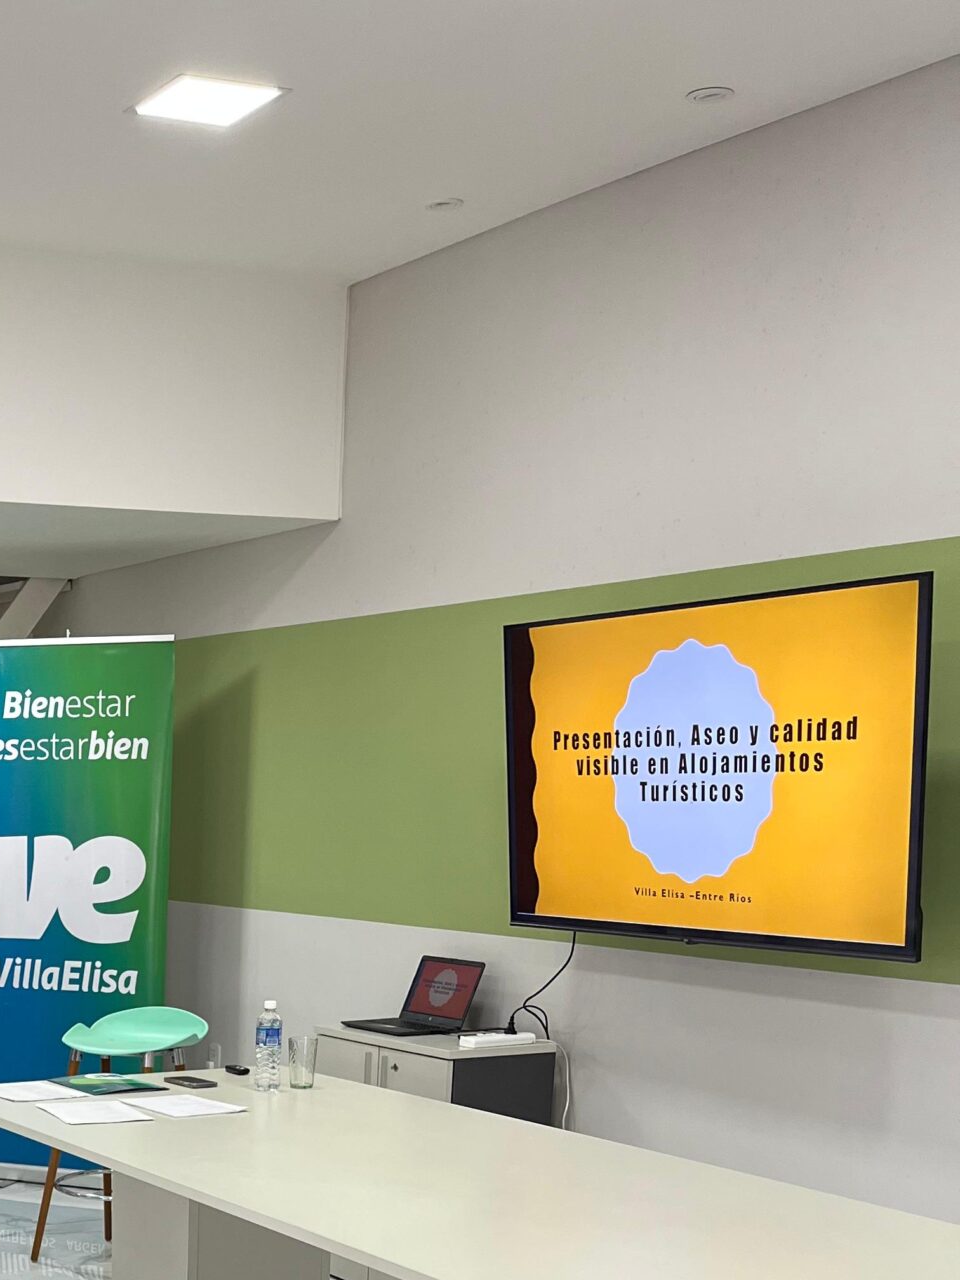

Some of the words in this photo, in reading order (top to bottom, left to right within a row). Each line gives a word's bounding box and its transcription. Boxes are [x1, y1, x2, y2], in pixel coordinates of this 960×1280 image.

[2, 688, 137, 720] Bienestar
[552, 725, 682, 751] Presentación,
[690, 723, 739, 746] Aseo
[749, 724, 759, 746] y
[769, 716, 858, 744] calidad
[576, 755, 639, 776] visible
[647, 755, 669, 776] en
[678, 750, 824, 776] Alojamientos
[639, 780, 744, 803] Turísticos
[634, 886, 657, 897] Villa
[661, 888, 685, 899] Elisa
